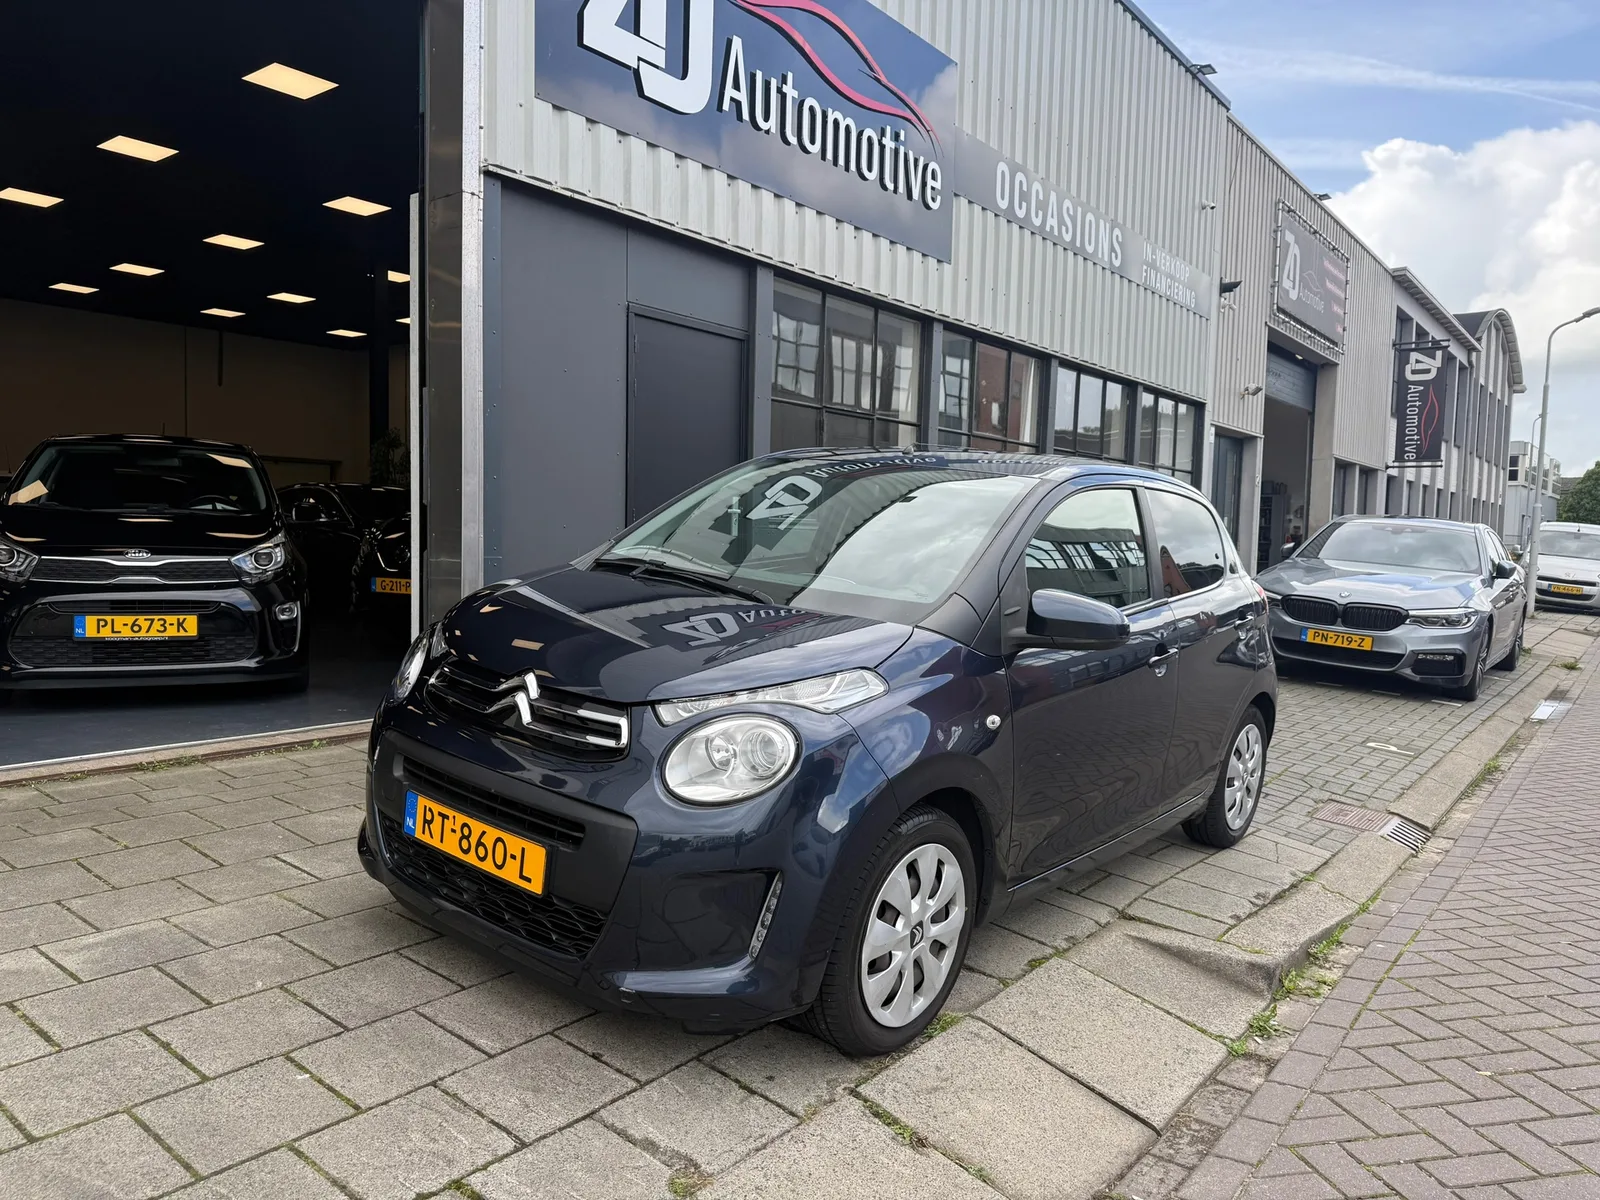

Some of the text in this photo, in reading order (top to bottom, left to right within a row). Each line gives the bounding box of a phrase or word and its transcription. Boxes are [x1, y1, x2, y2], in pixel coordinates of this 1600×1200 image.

[719, 35, 942, 211] Automotive
[996, 161, 1122, 268] OCCASIONS
[1142, 264, 1196, 308] FINANCIERING
[1143, 240, 1190, 283] IN-VERKOOP
[1404, 384, 1425, 460] Automotive
[96, 617, 188, 634] PL-673-K
[1313, 631, 1366, 648] PN-719-Z
[406, 816, 415, 829] NL
[421, 804, 532, 884] RT-860-L
